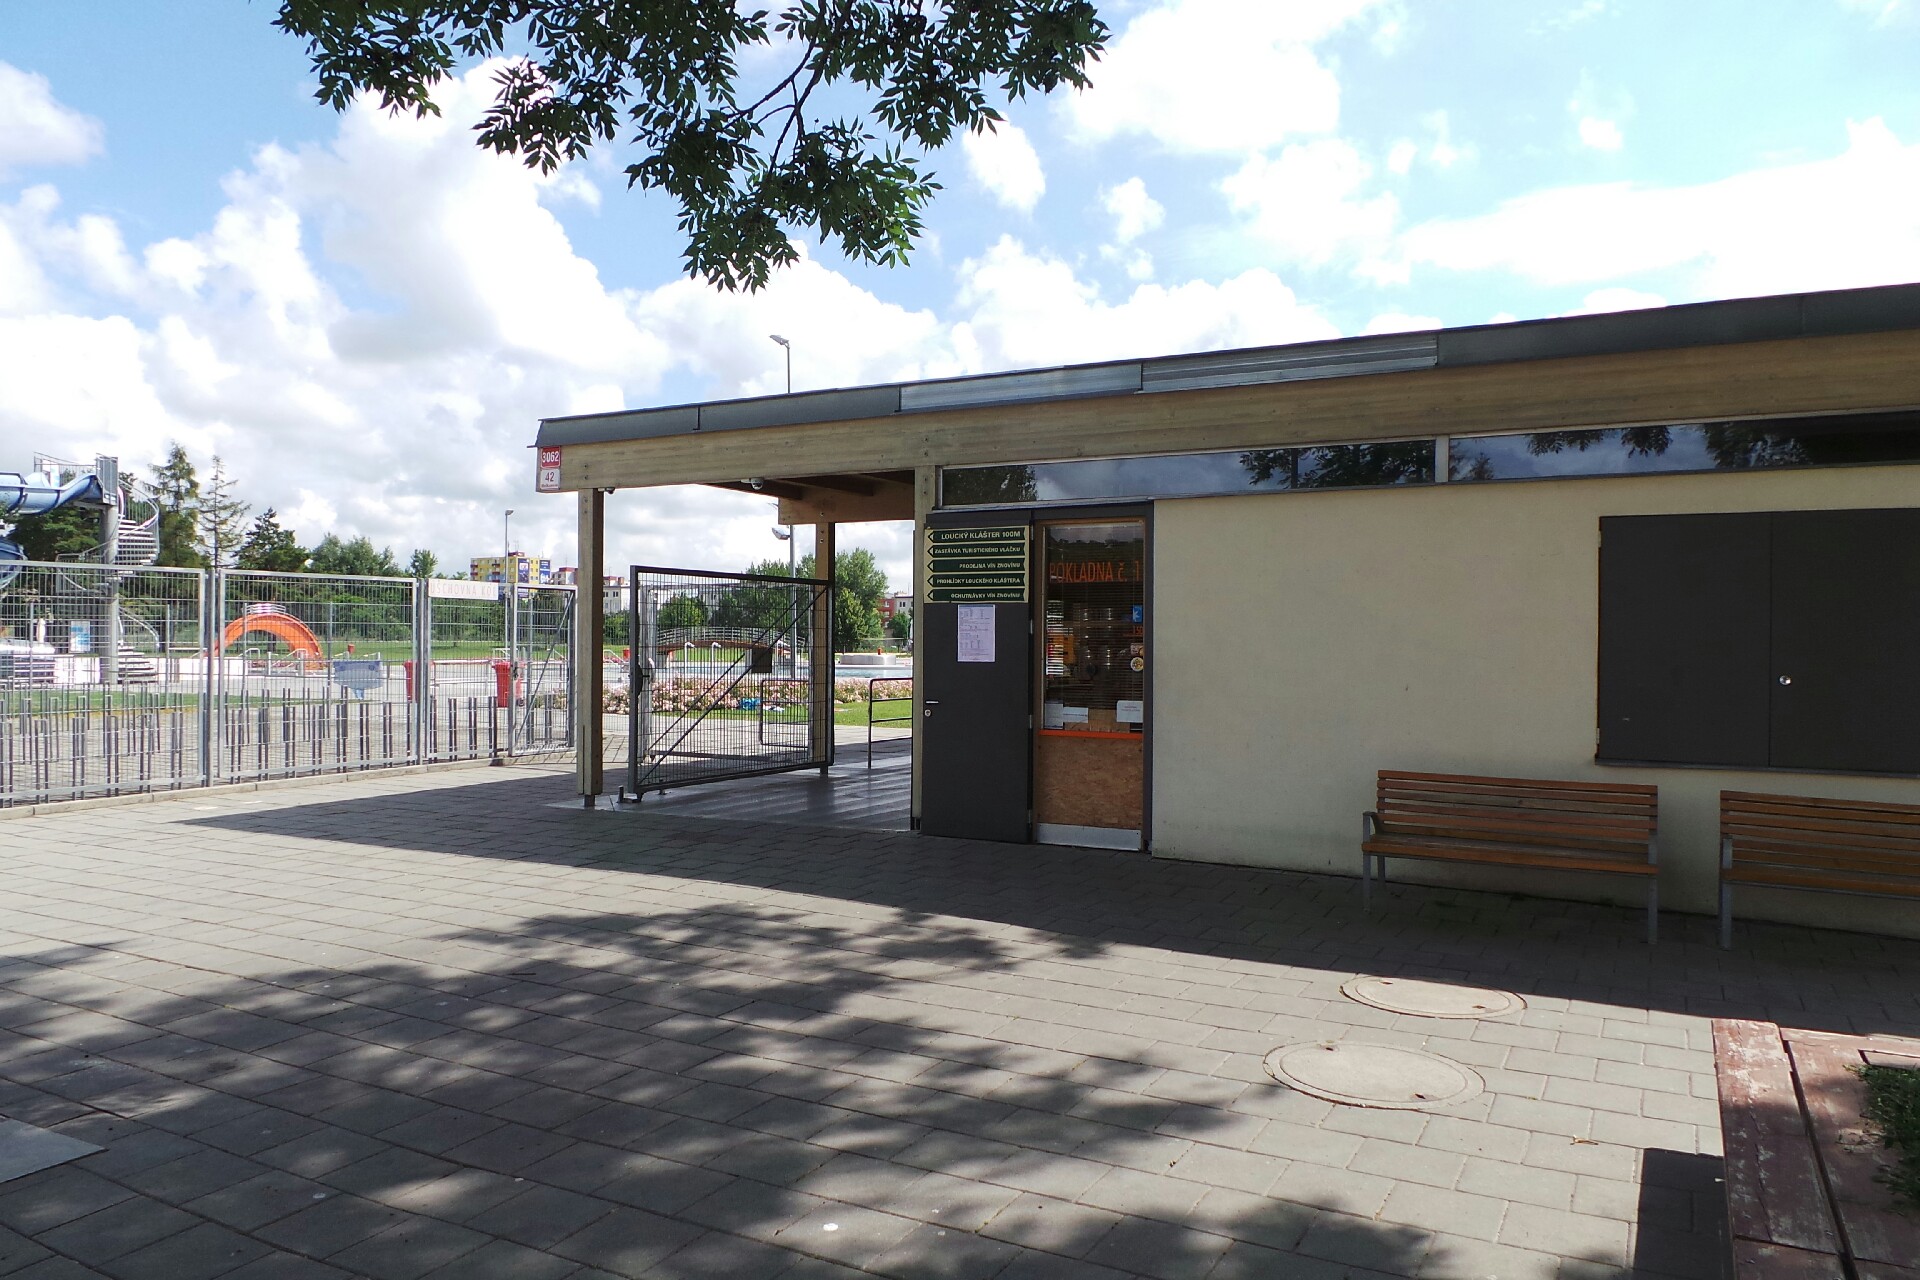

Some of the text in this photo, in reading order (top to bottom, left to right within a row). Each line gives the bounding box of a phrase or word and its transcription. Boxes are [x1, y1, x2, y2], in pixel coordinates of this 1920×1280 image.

[542, 451, 560, 463] 3062
[545, 472, 554, 482] 42
[941, 530, 1020, 540] LOUCKÝ KLÁŠTER 100M
[1050, 560, 1114, 584] POKLADNA
[1134, 560, 1140, 582] 1
